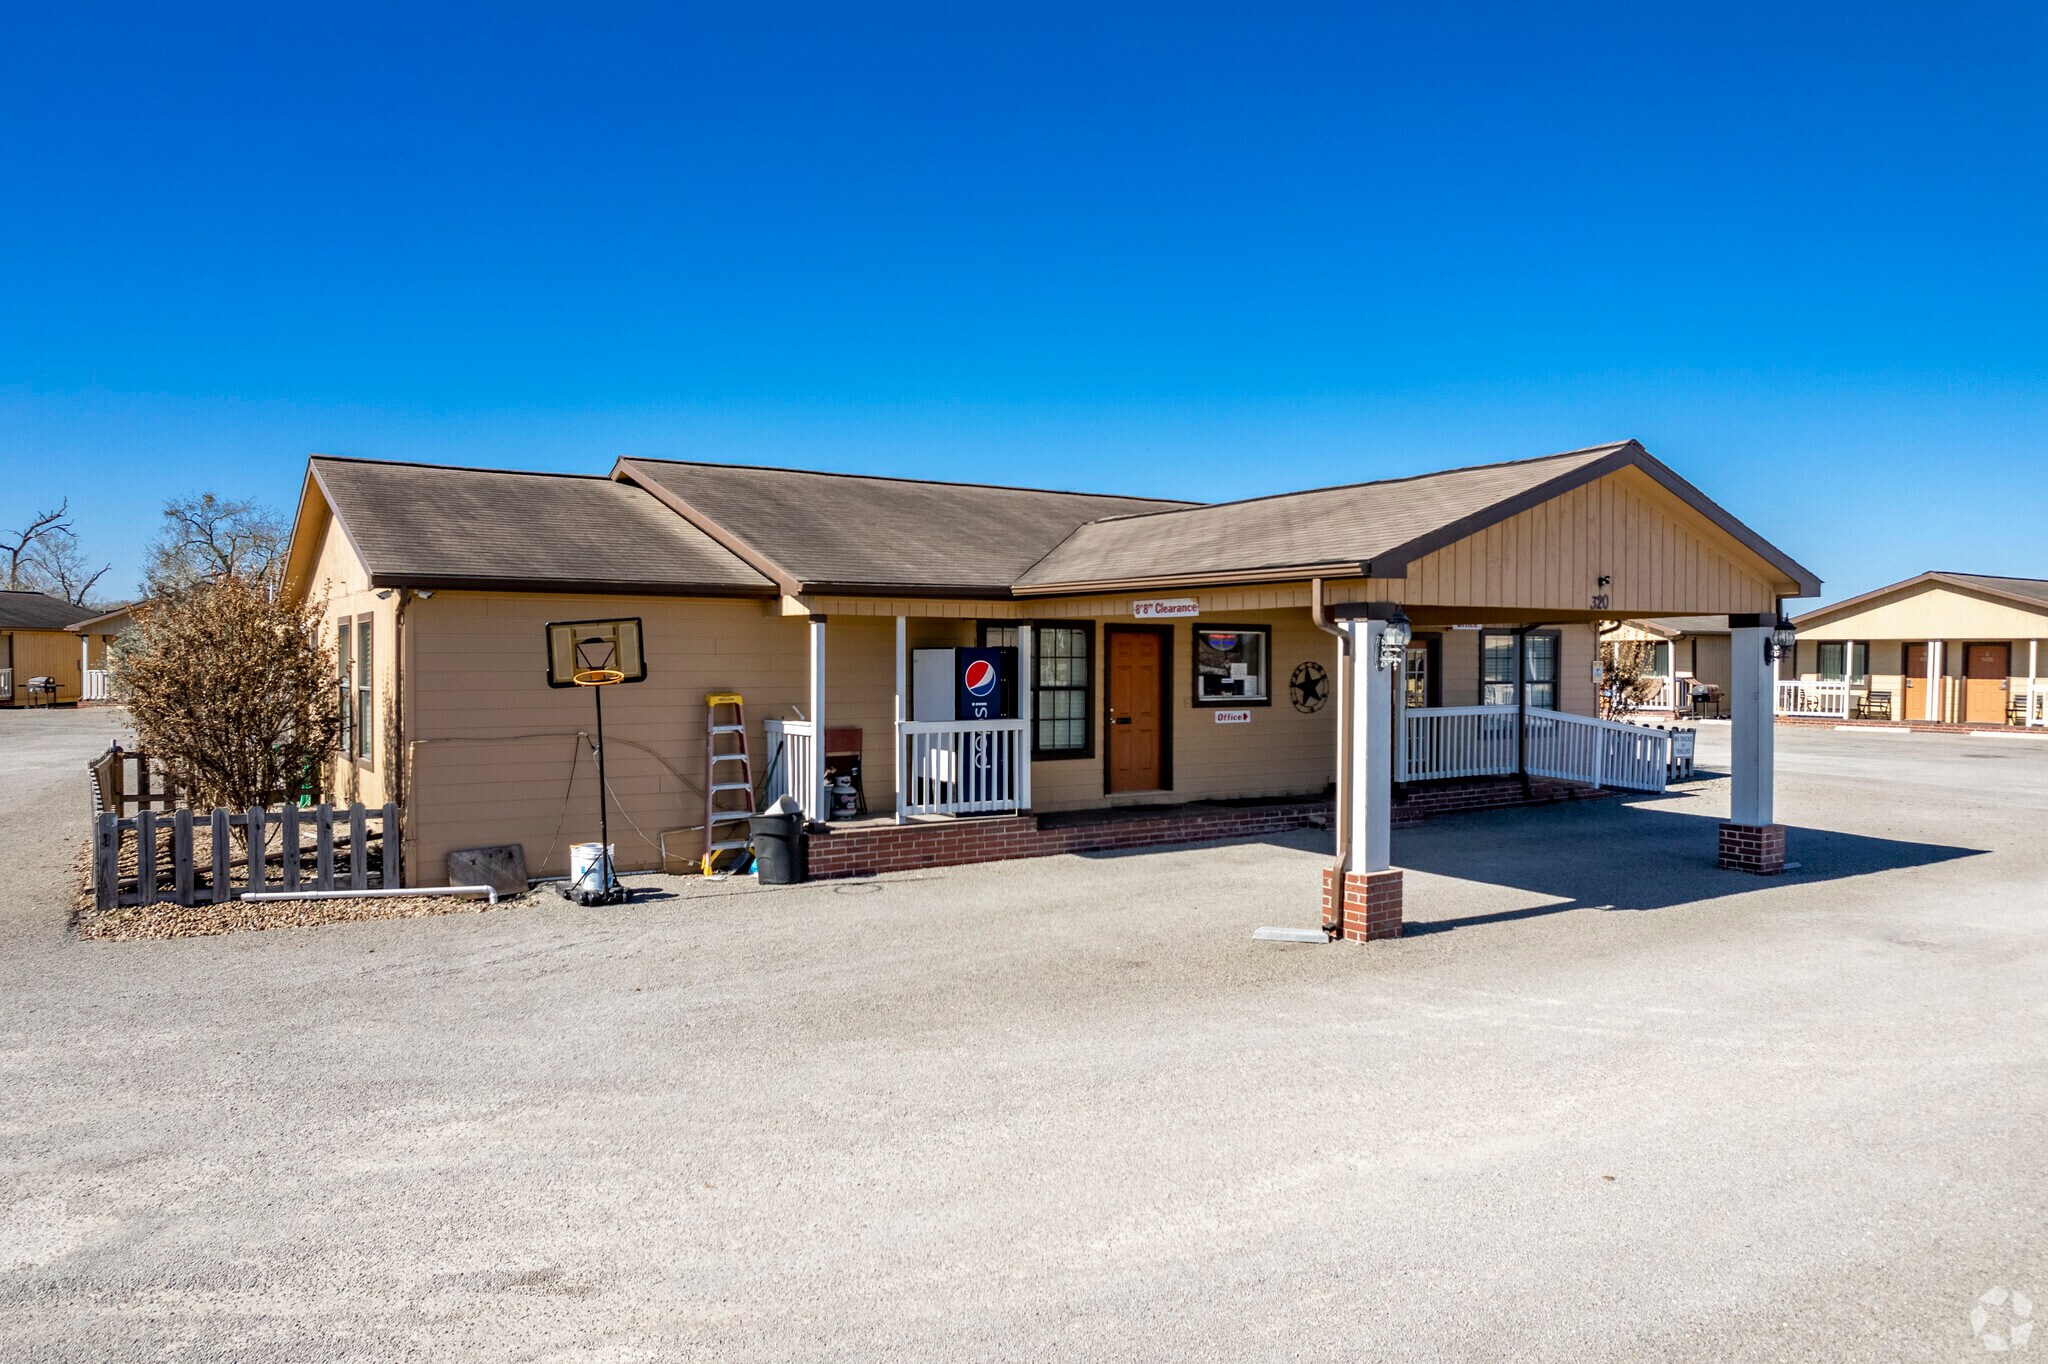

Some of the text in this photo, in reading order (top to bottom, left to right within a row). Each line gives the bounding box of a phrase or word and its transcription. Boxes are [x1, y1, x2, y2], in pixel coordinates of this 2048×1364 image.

[1155, 602, 1198, 614] Clearance
[1590, 594, 1609, 610] 320
[1217, 713, 1243, 721] Office
[972, 702, 991, 769] pesi
